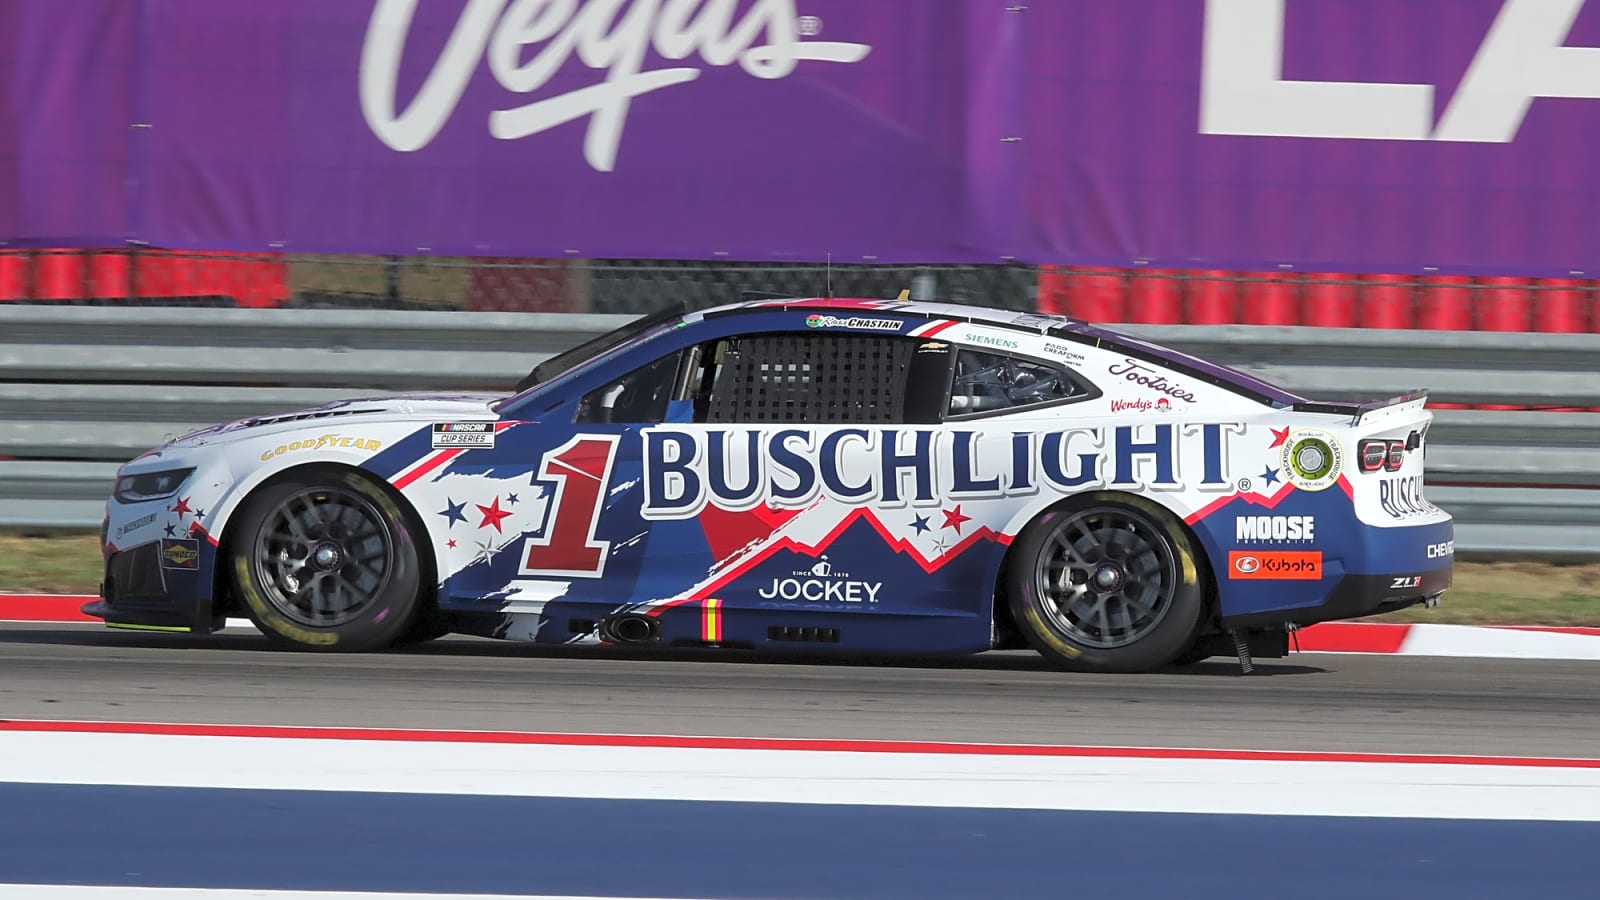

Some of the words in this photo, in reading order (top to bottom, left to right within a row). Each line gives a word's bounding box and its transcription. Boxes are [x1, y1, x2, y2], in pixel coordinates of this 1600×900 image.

[848, 317, 903, 330] CHASTAIN
[965, 333, 1019, 349] SIEMENS
[1043, 346, 1085, 361] CREAFORM
[1108, 358, 1197, 403] Tootsies
[1111, 398, 1152, 413] Wendy's
[454, 424, 486, 432] NASCAR
[440, 434, 457, 443] CUP
[457, 434, 486, 443] SERIES
[260, 433, 382, 461] GOODYEAR
[1328, 437, 1341, 481] TRACKHOUSE
[517, 433, 622, 579] 1
[1236, 516, 1314, 540] MOOSE
[164, 550, 197, 559] SUNOCO
[1261, 558, 1316, 572] Kubota
[1389, 576, 1422, 589] ZL1
[758, 578, 882, 603] JOCKEY
